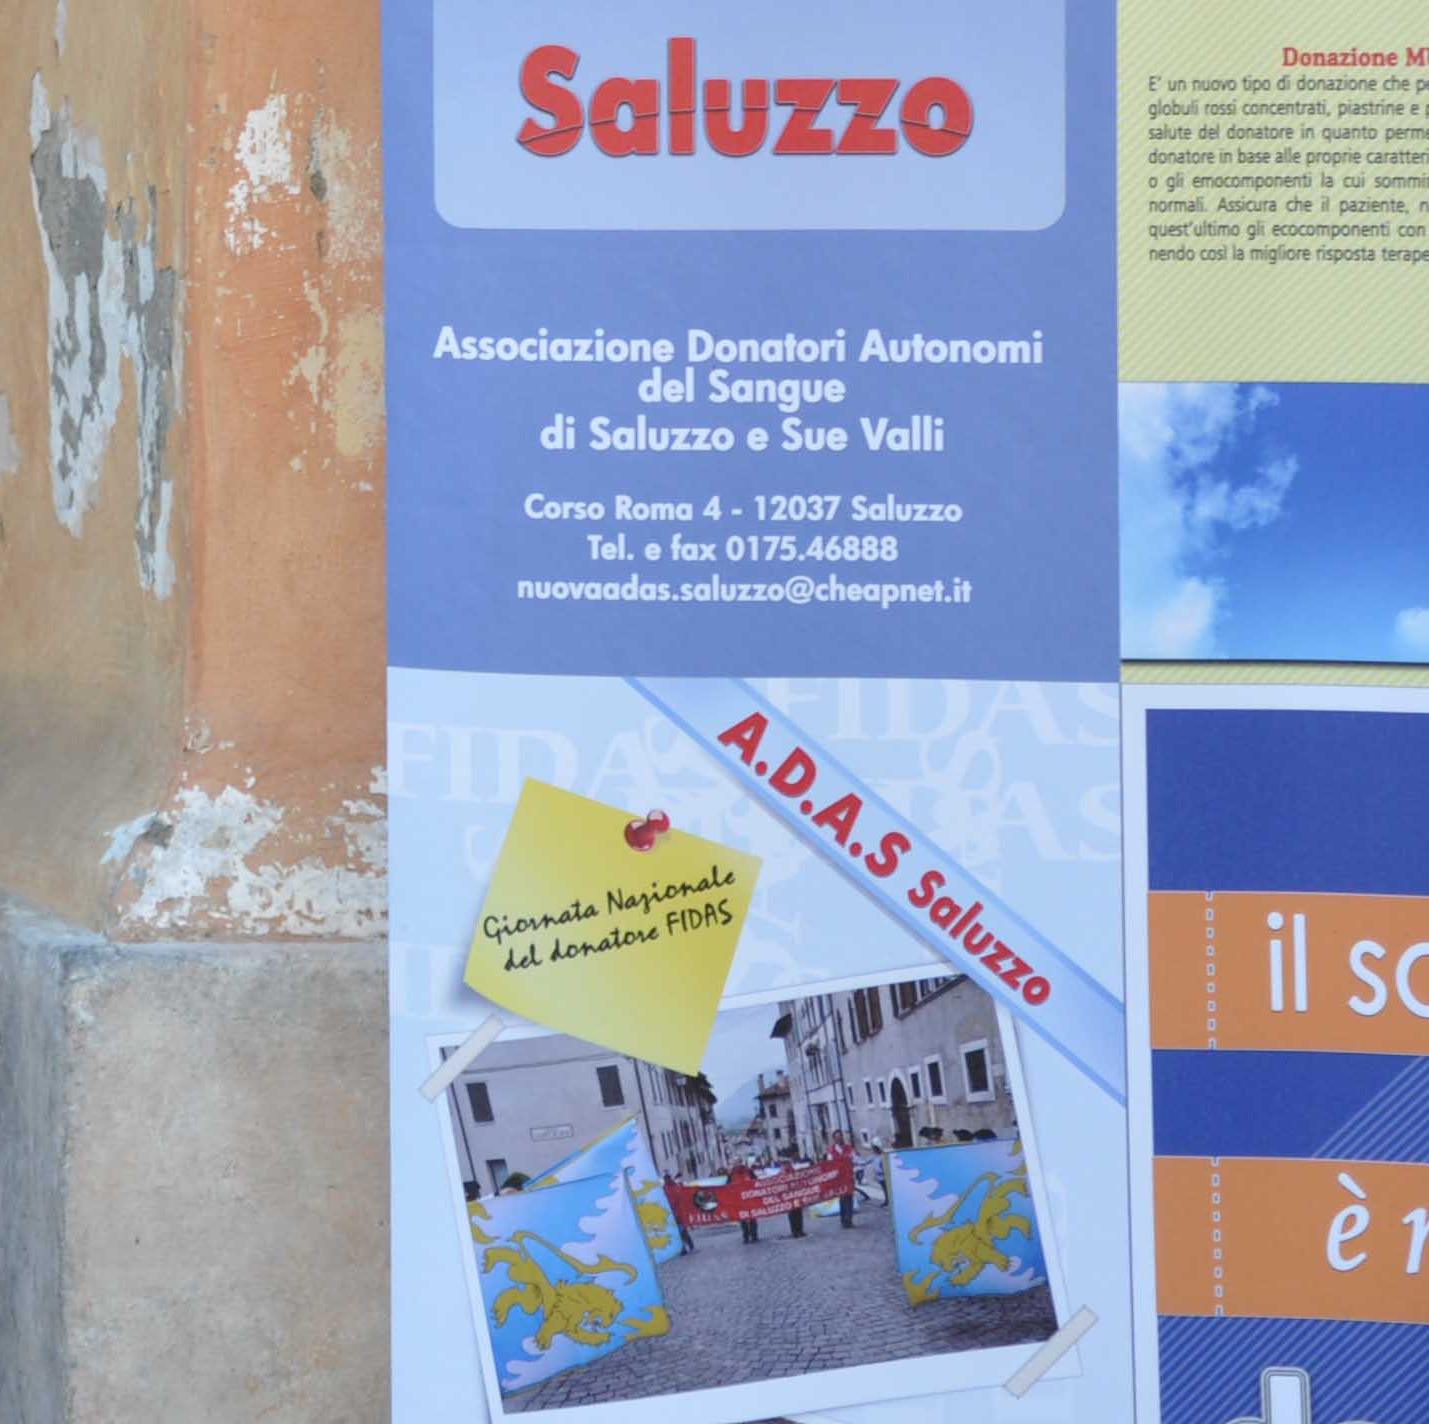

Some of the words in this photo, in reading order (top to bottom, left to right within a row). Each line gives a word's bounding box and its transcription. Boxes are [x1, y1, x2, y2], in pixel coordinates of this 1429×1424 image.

[1282, 47, 1398, 67] Donazione
[517, 35, 974, 158] Saluzzo
[1149, 101, 1199, 119] globuli
[1205, 101, 1237, 116] rossi
[1242, 100, 1330, 117] concentrati,
[1338, 100, 1404, 119] piastrine
[1149, 125, 1191, 140] salute
[1198, 124, 1220, 140] del
[1227, 124, 1294, 140] donatore
[1301, 123, 1314, 139] in
[1322, 124, 1377, 143] quanto
[433, 326, 675, 365] Associazione
[687, 329, 846, 365] Donatori
[860, 330, 1043, 366] Autonomi
[638, 368, 695, 406] del
[708, 370, 845, 414] Sangue
[540, 415, 575, 452] di
[589, 416, 735, 453] Saluzzo
[746, 425, 769, 453] e
[781, 418, 847, 453] Sue
[860, 417, 944, 453] Valli
[524, 494, 605, 522] Corso
[614, 494, 693, 523] Roma
[703, 494, 722, 522] 4
[753, 495, 841, 523] 12037
[851, 495, 963, 525] Saluzzo
[587, 533, 634, 562] Tel.
[645, 541, 663, 562] e
[670, 533, 717, 562] fax
[725, 535, 899, 562] 0175.46888
[517, 574, 972, 609] nuovaadas.saluzzo@cheapnet.it
[716, 711, 912, 878] A.D.A.S
[907, 869, 1052, 1006] Saluzzo
[483, 900, 598, 944] Giornata
[607, 865, 736, 915] Nazionale
[504, 945, 542, 972] del
[551, 925, 659, 964] donatore
[666, 899, 733, 936] FIDAS
[1267, 911, 1307, 1013] il
[1326, 1172, 1371, 1273] è
